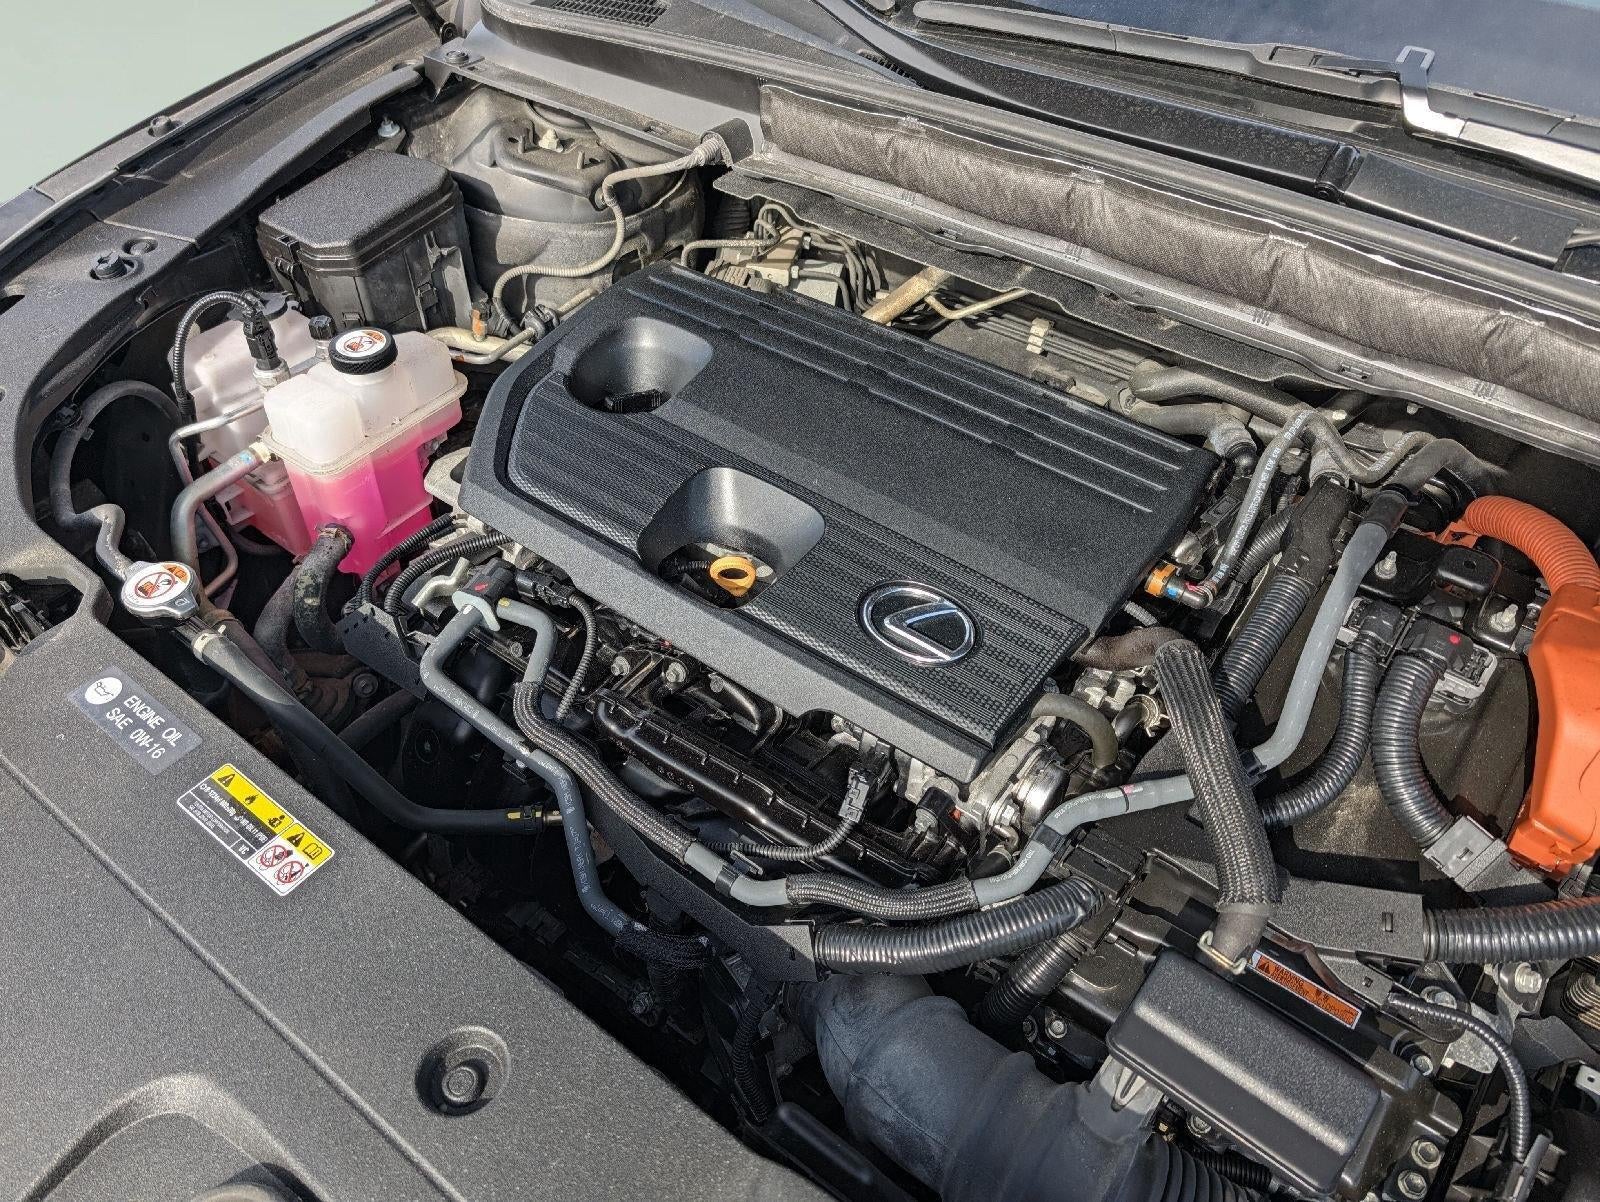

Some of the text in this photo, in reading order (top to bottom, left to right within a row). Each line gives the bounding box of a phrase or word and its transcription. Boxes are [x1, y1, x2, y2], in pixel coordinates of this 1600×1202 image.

[105, 707, 166, 759] SAE 0W-16
[123, 695, 183, 748] ENGINE OIL
